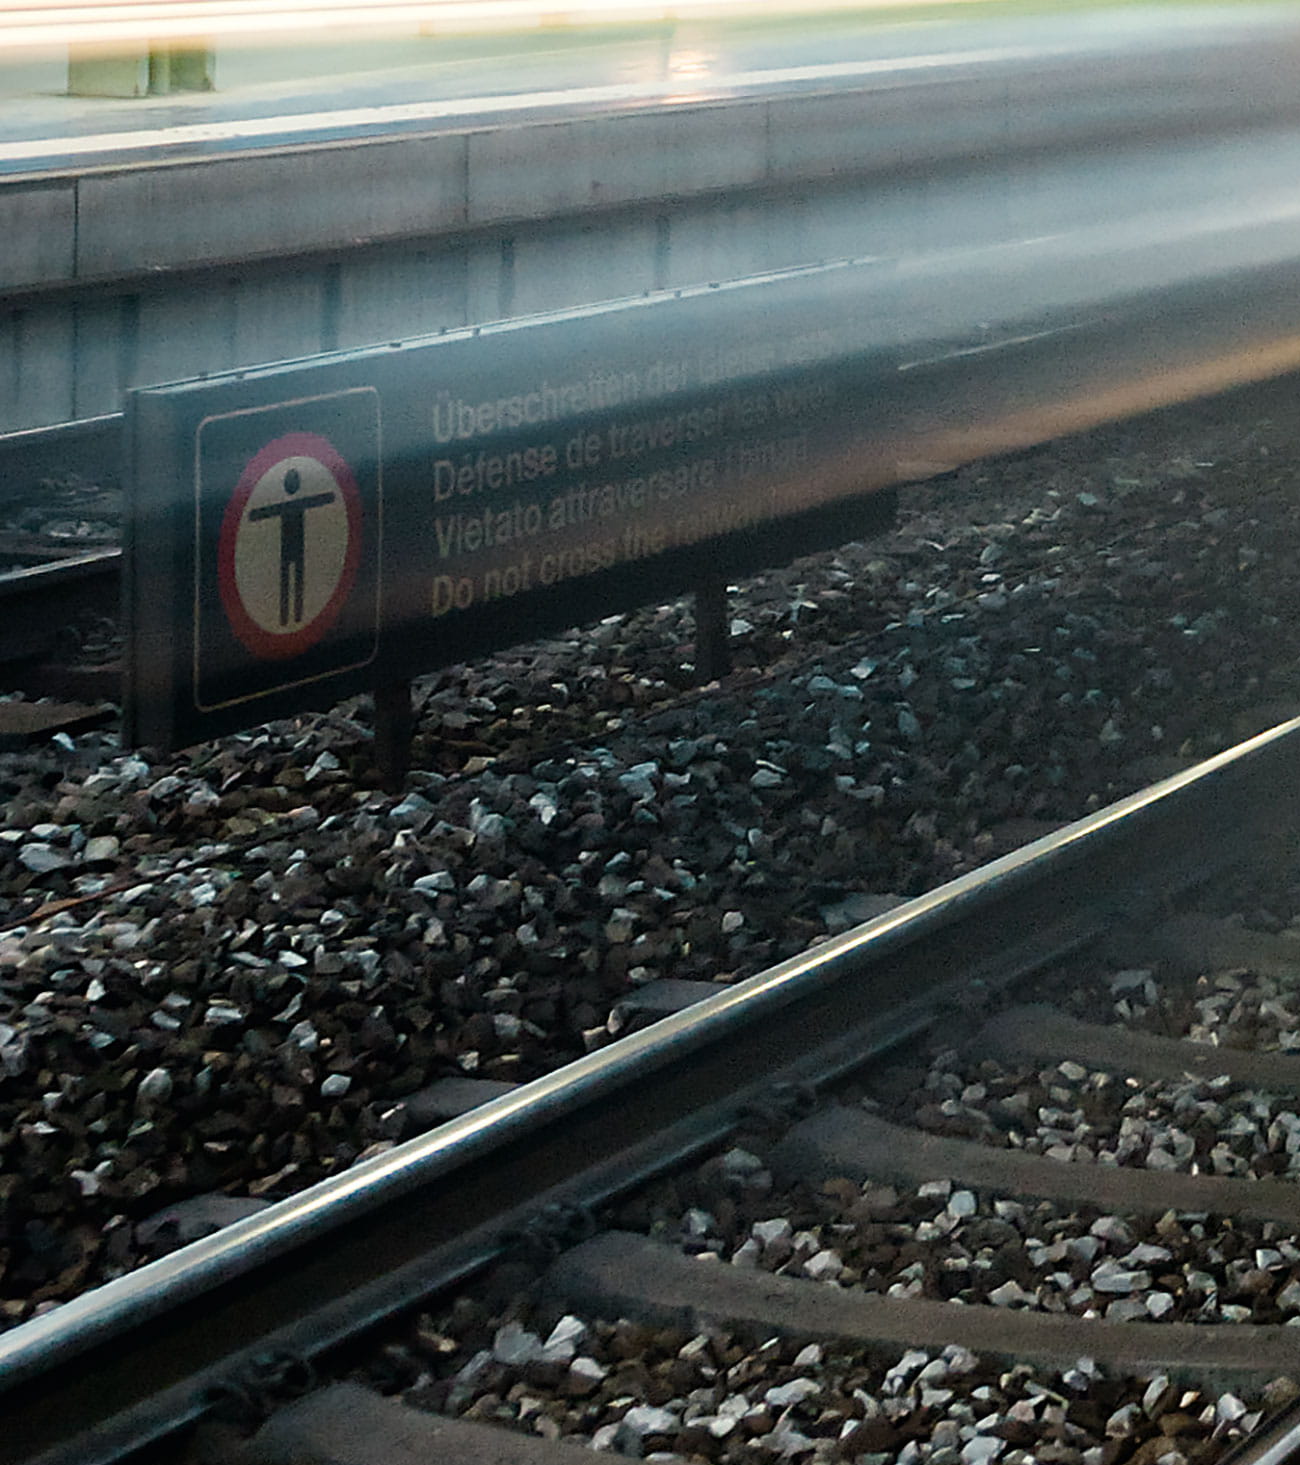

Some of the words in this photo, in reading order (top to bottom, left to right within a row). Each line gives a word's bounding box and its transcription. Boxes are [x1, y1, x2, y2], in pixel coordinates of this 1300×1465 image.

[433, 368, 636, 443] Überschreiten
[434, 450, 556, 501] Défense
[566, 428, 600, 469] de
[434, 501, 542, 559] Vietato
[550, 458, 714, 527] attraversare
[433, 573, 474, 617] Do
[484, 556, 532, 601] not
[540, 539, 614, 585] cross
[625, 520, 664, 560] the
